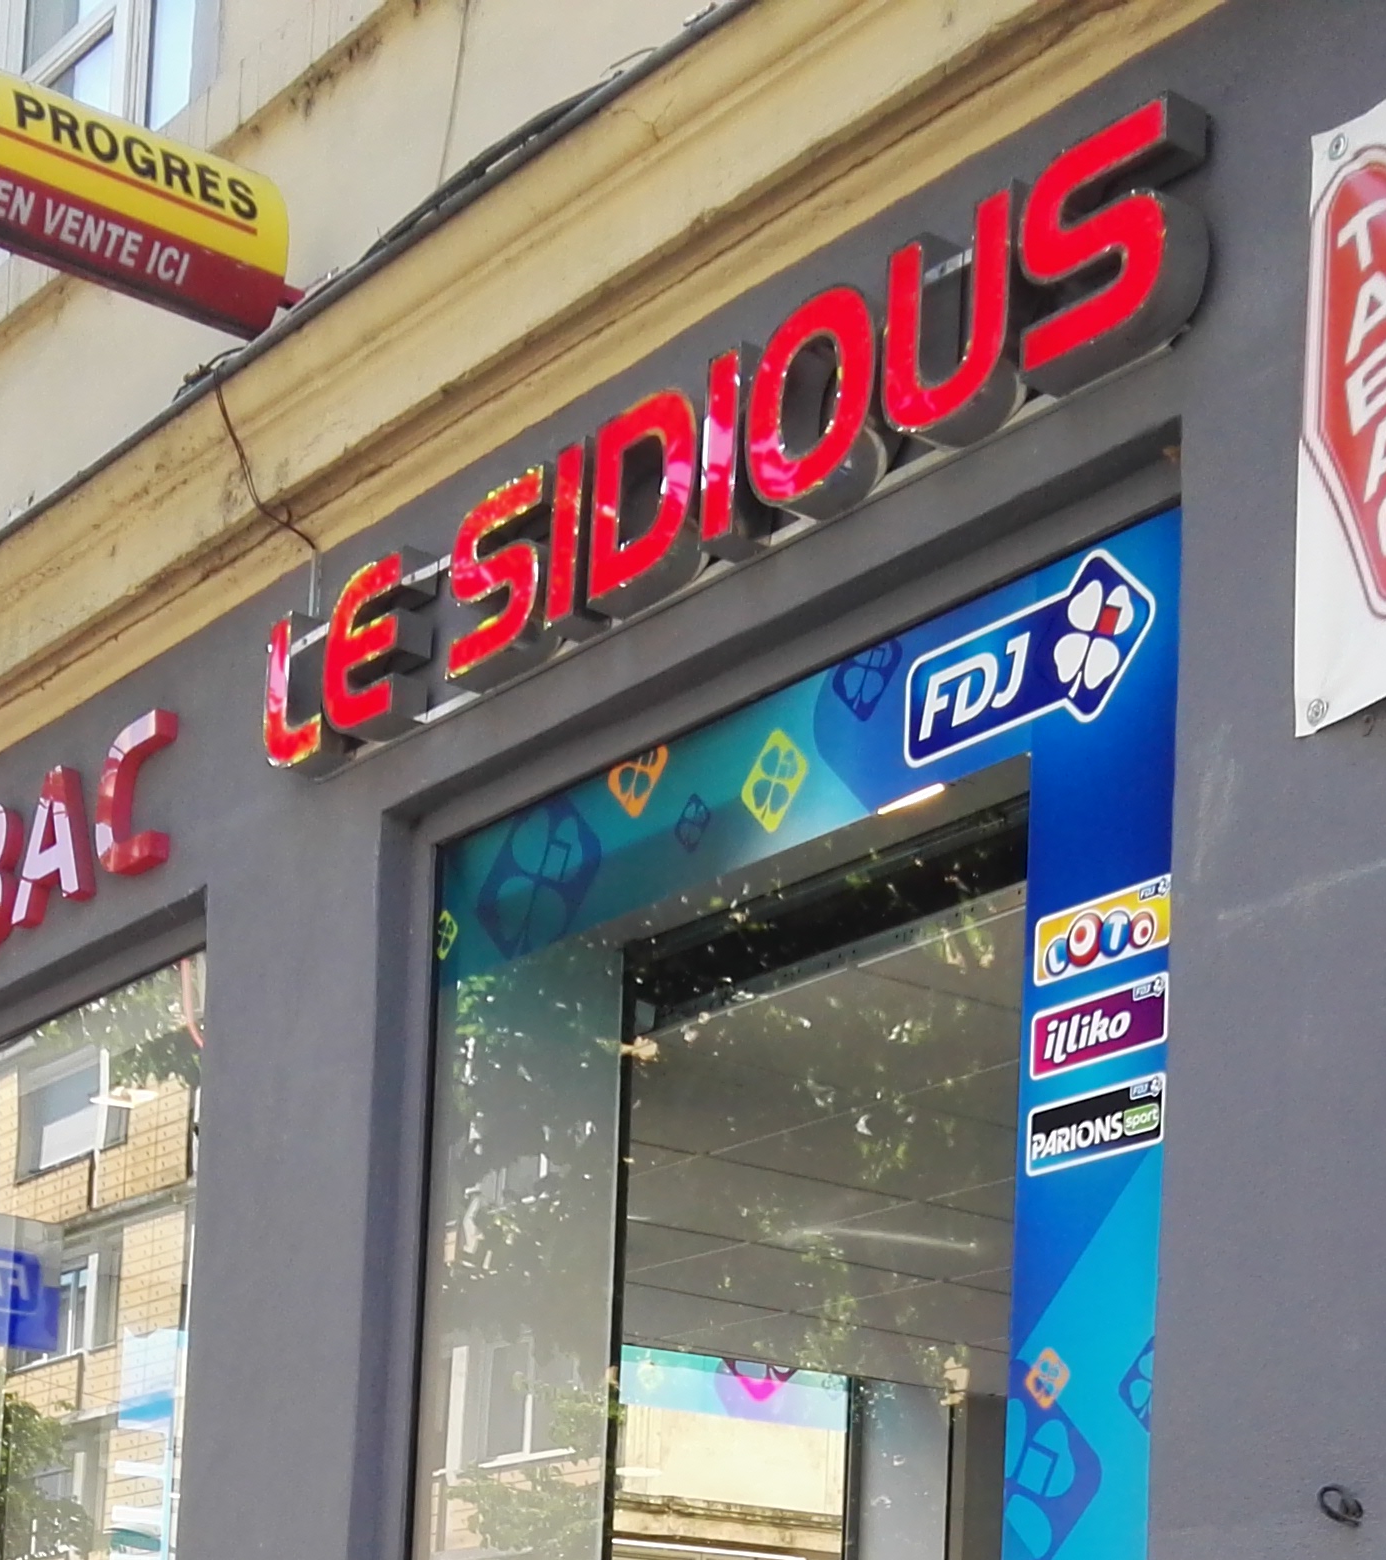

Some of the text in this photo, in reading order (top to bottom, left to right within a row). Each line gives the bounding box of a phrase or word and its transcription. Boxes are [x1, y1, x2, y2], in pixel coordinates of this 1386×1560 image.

[15, 91, 258, 221] PROGRES
[44, 197, 144, 267] VENTE
[146, 244, 191, 286] ICI
[261, 98, 1183, 770] LE SIDIOUS
[917, 641, 1028, 741] FDJ
[1045, 908, 1156, 976] LOTO
[1043, 1008, 1131, 1064] illiko
[1030, 1106, 1159, 1161] PARIONS sport
